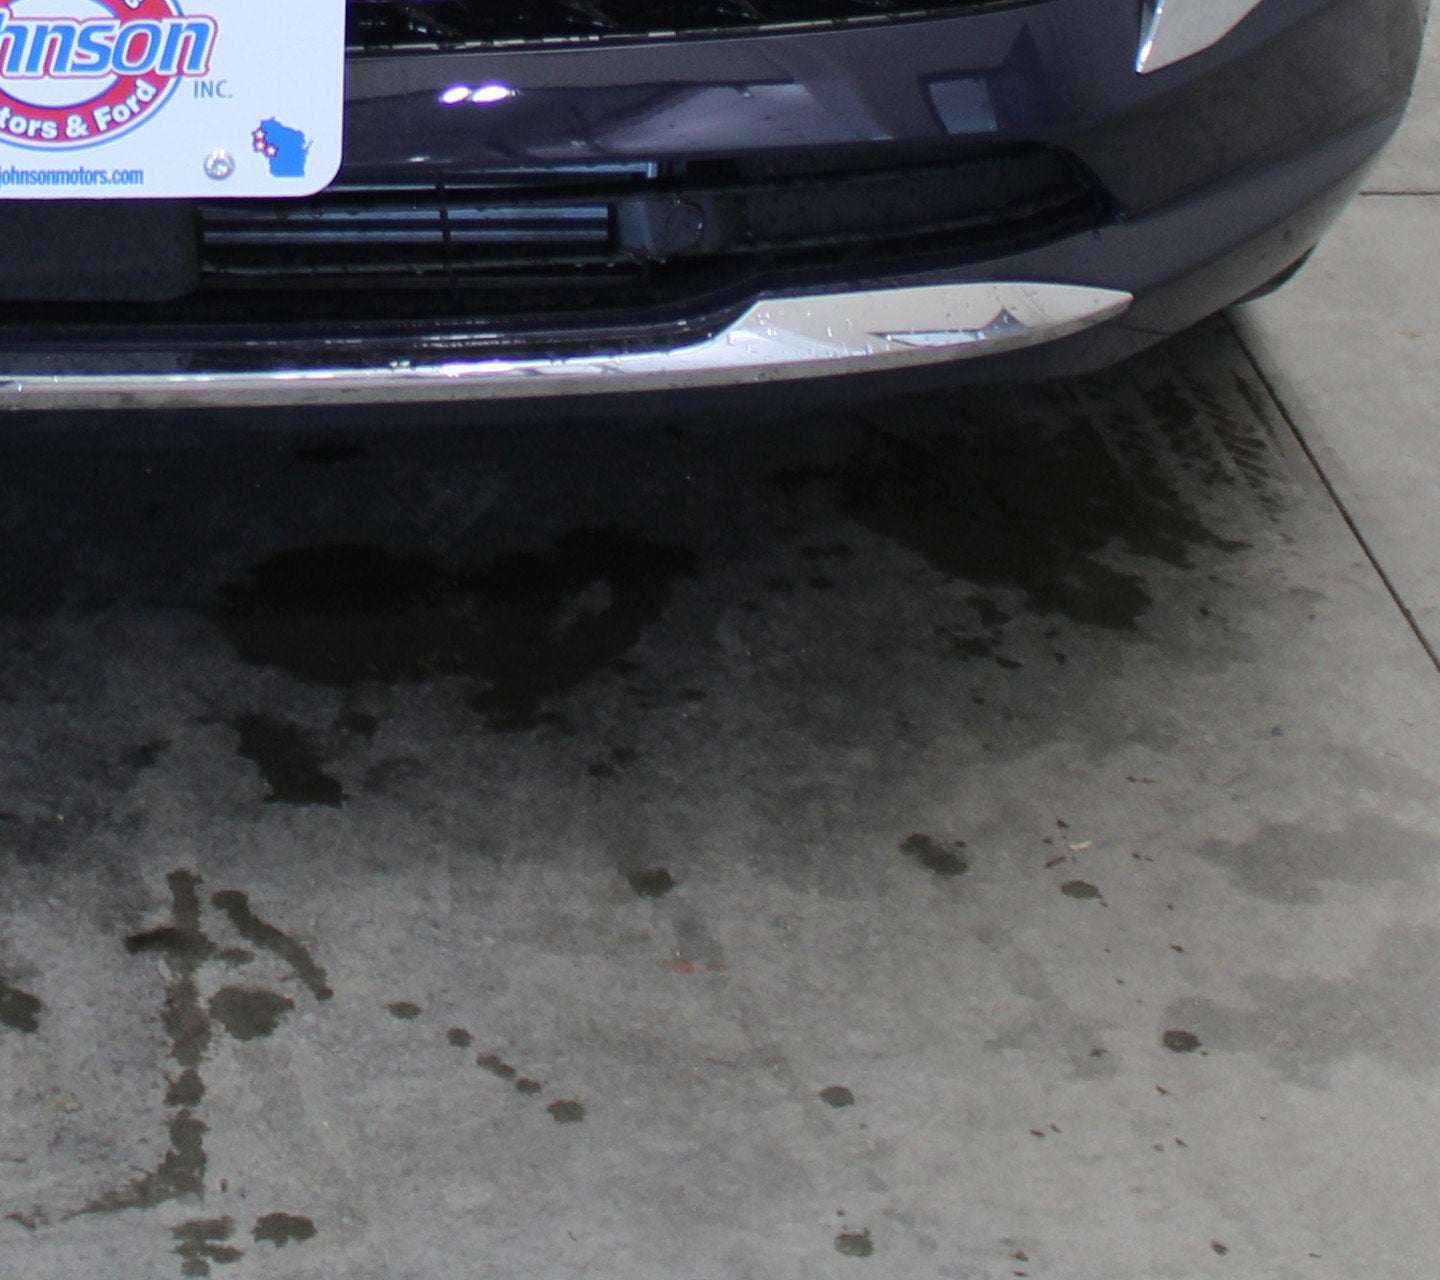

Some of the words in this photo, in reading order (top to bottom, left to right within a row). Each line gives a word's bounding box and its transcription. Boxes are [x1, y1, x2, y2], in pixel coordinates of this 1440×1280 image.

[65, 113, 90, 139] &
[92, 78, 158, 133] Ford
[193, 80, 233, 99] INC.
